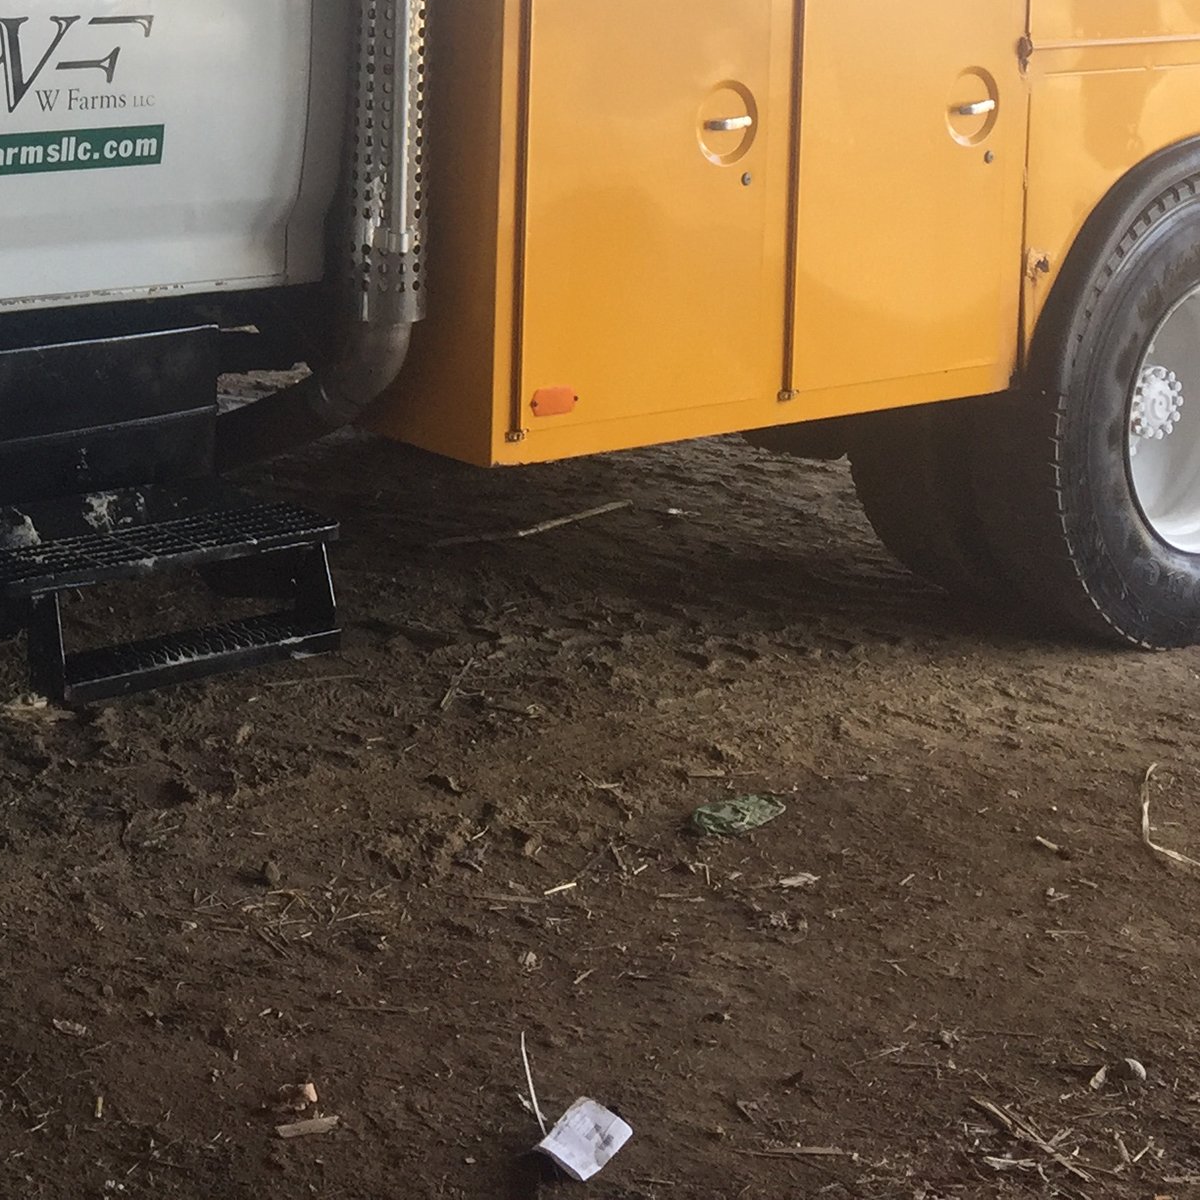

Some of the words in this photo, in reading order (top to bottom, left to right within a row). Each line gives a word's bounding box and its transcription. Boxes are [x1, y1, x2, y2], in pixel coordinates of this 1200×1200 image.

[34, 88, 60, 112] W
[66, 87, 128, 111] Farms
[132, 94, 156, 108] LLC
